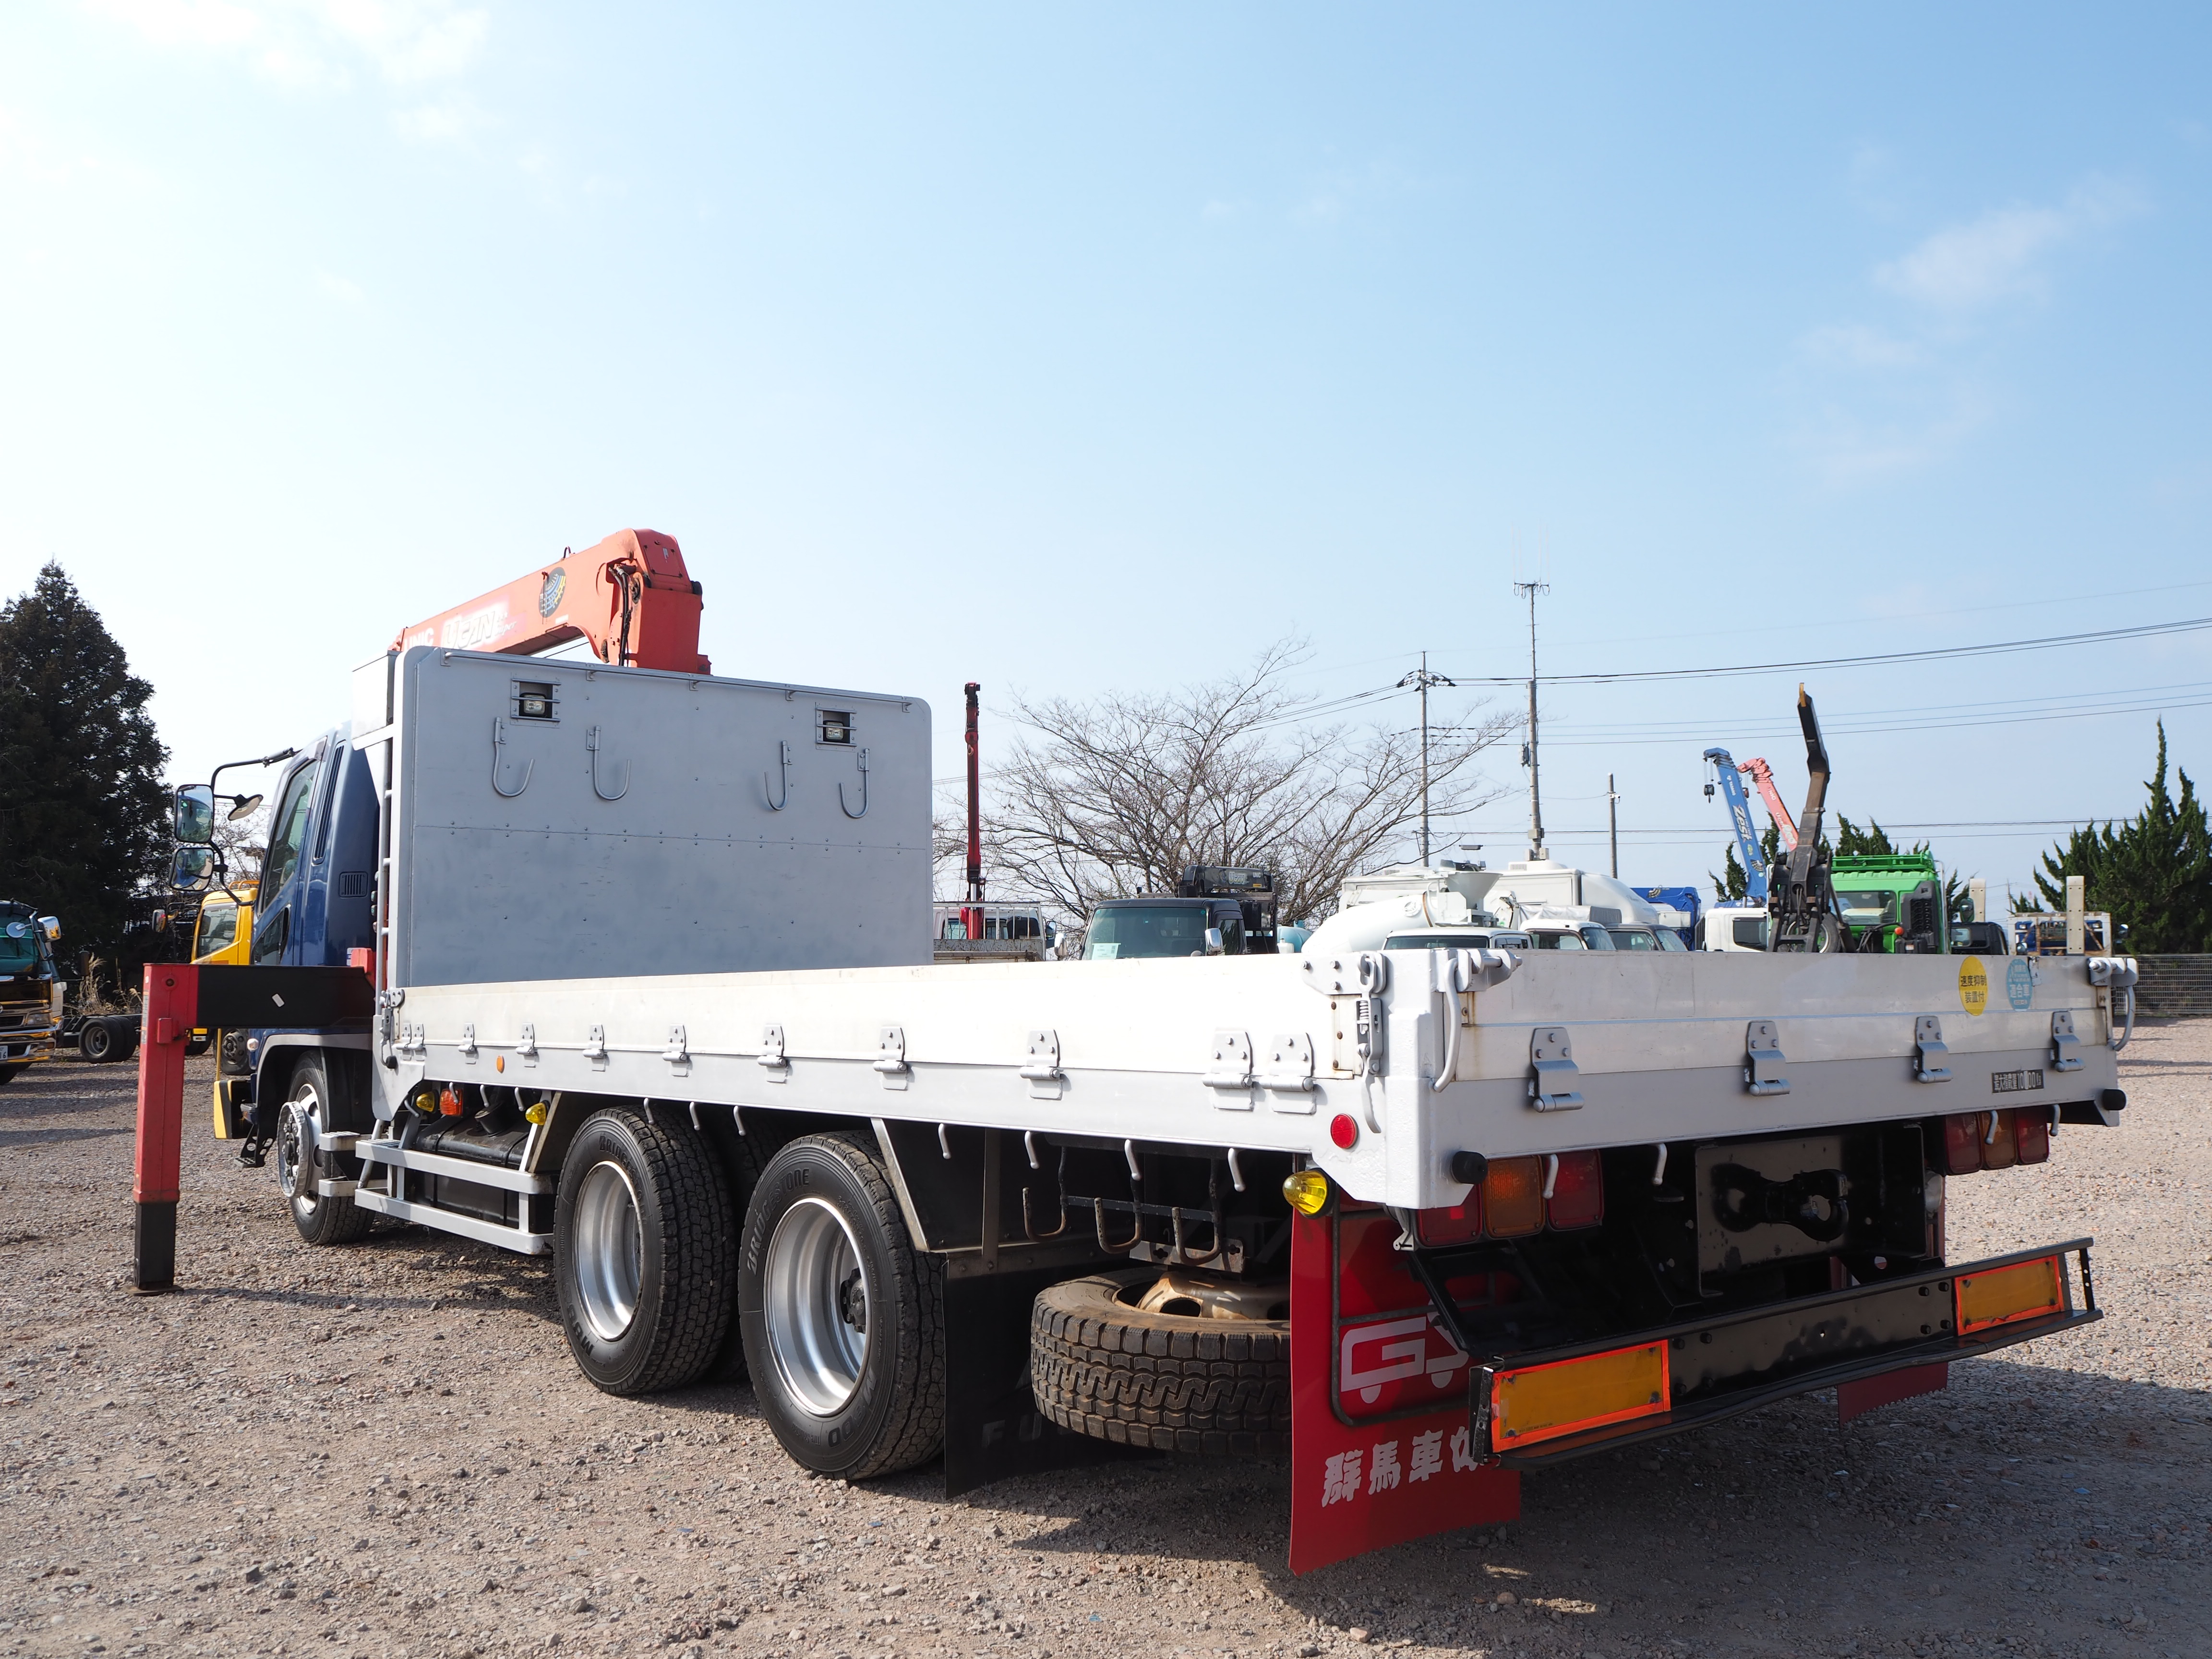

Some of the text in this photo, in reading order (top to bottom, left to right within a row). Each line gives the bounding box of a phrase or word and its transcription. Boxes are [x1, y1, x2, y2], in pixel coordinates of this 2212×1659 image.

[1732, 805, 1752, 840] Zest
[1960, 975, 1987, 987] 速度抑制
[1965, 990, 1984, 1003] 装置付
[747, 1167, 810, 1275] BRIDGESTONE
